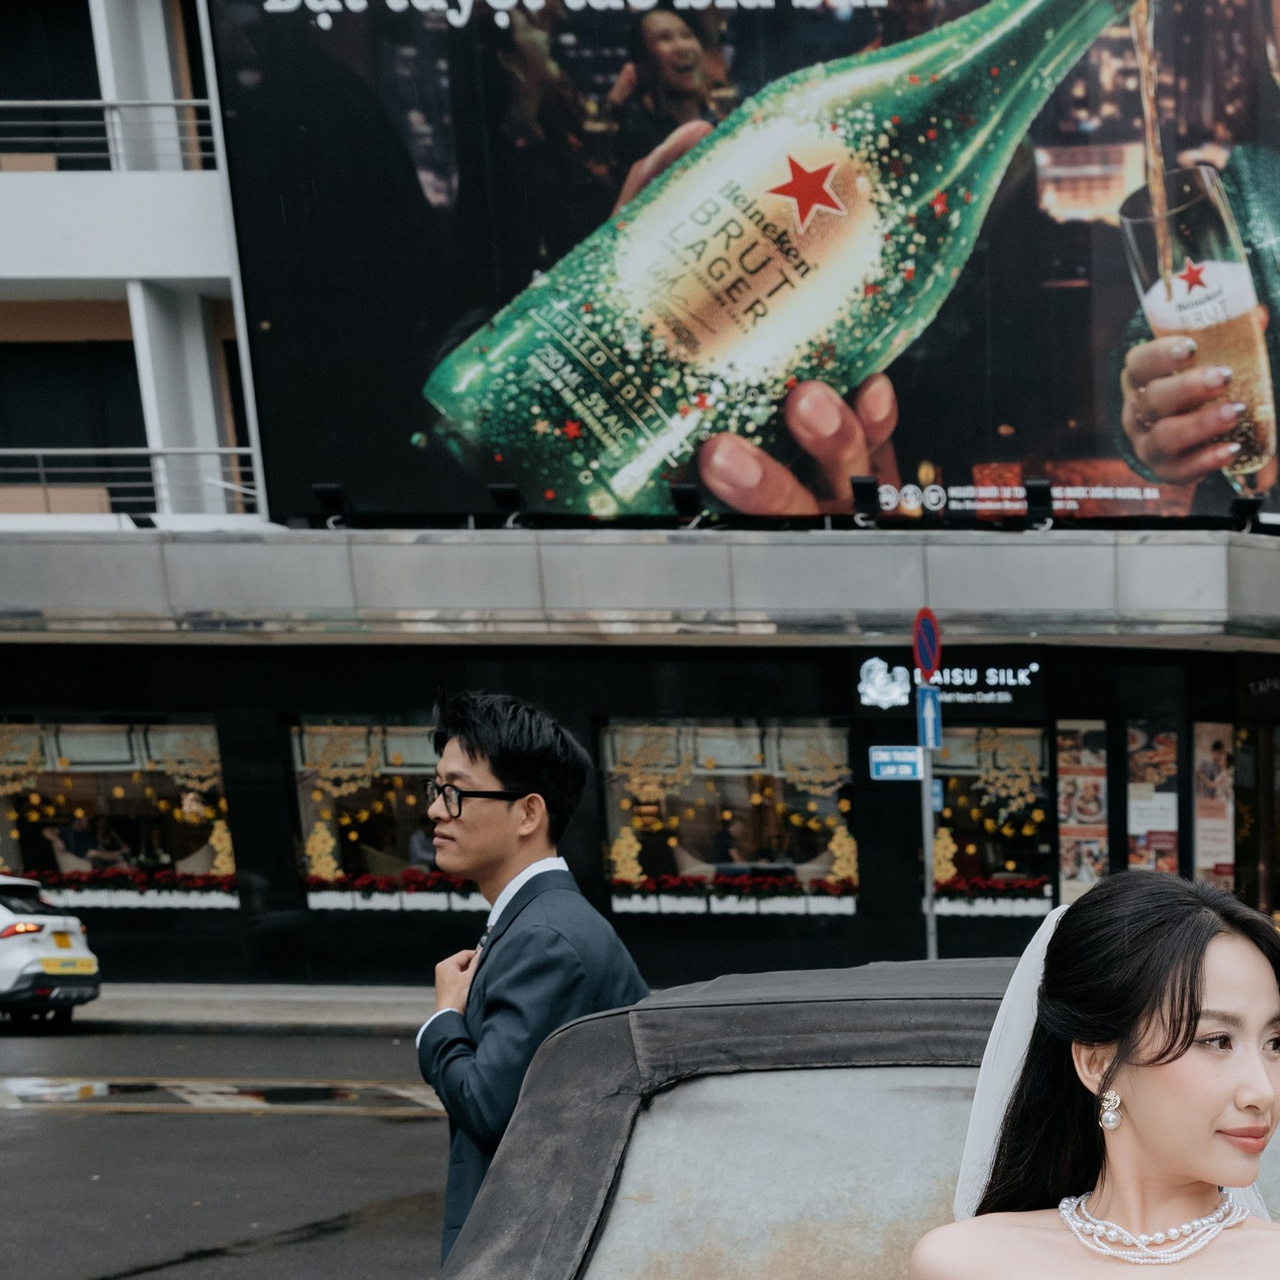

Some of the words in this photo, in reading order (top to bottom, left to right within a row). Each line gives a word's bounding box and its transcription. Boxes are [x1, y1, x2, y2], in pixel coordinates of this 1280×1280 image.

[667, 220, 769, 328] LAGER
[689, 198, 797, 298] BRUT
[717, 180, 812, 279] Heineken
[985, 667, 1032, 686] SILK
